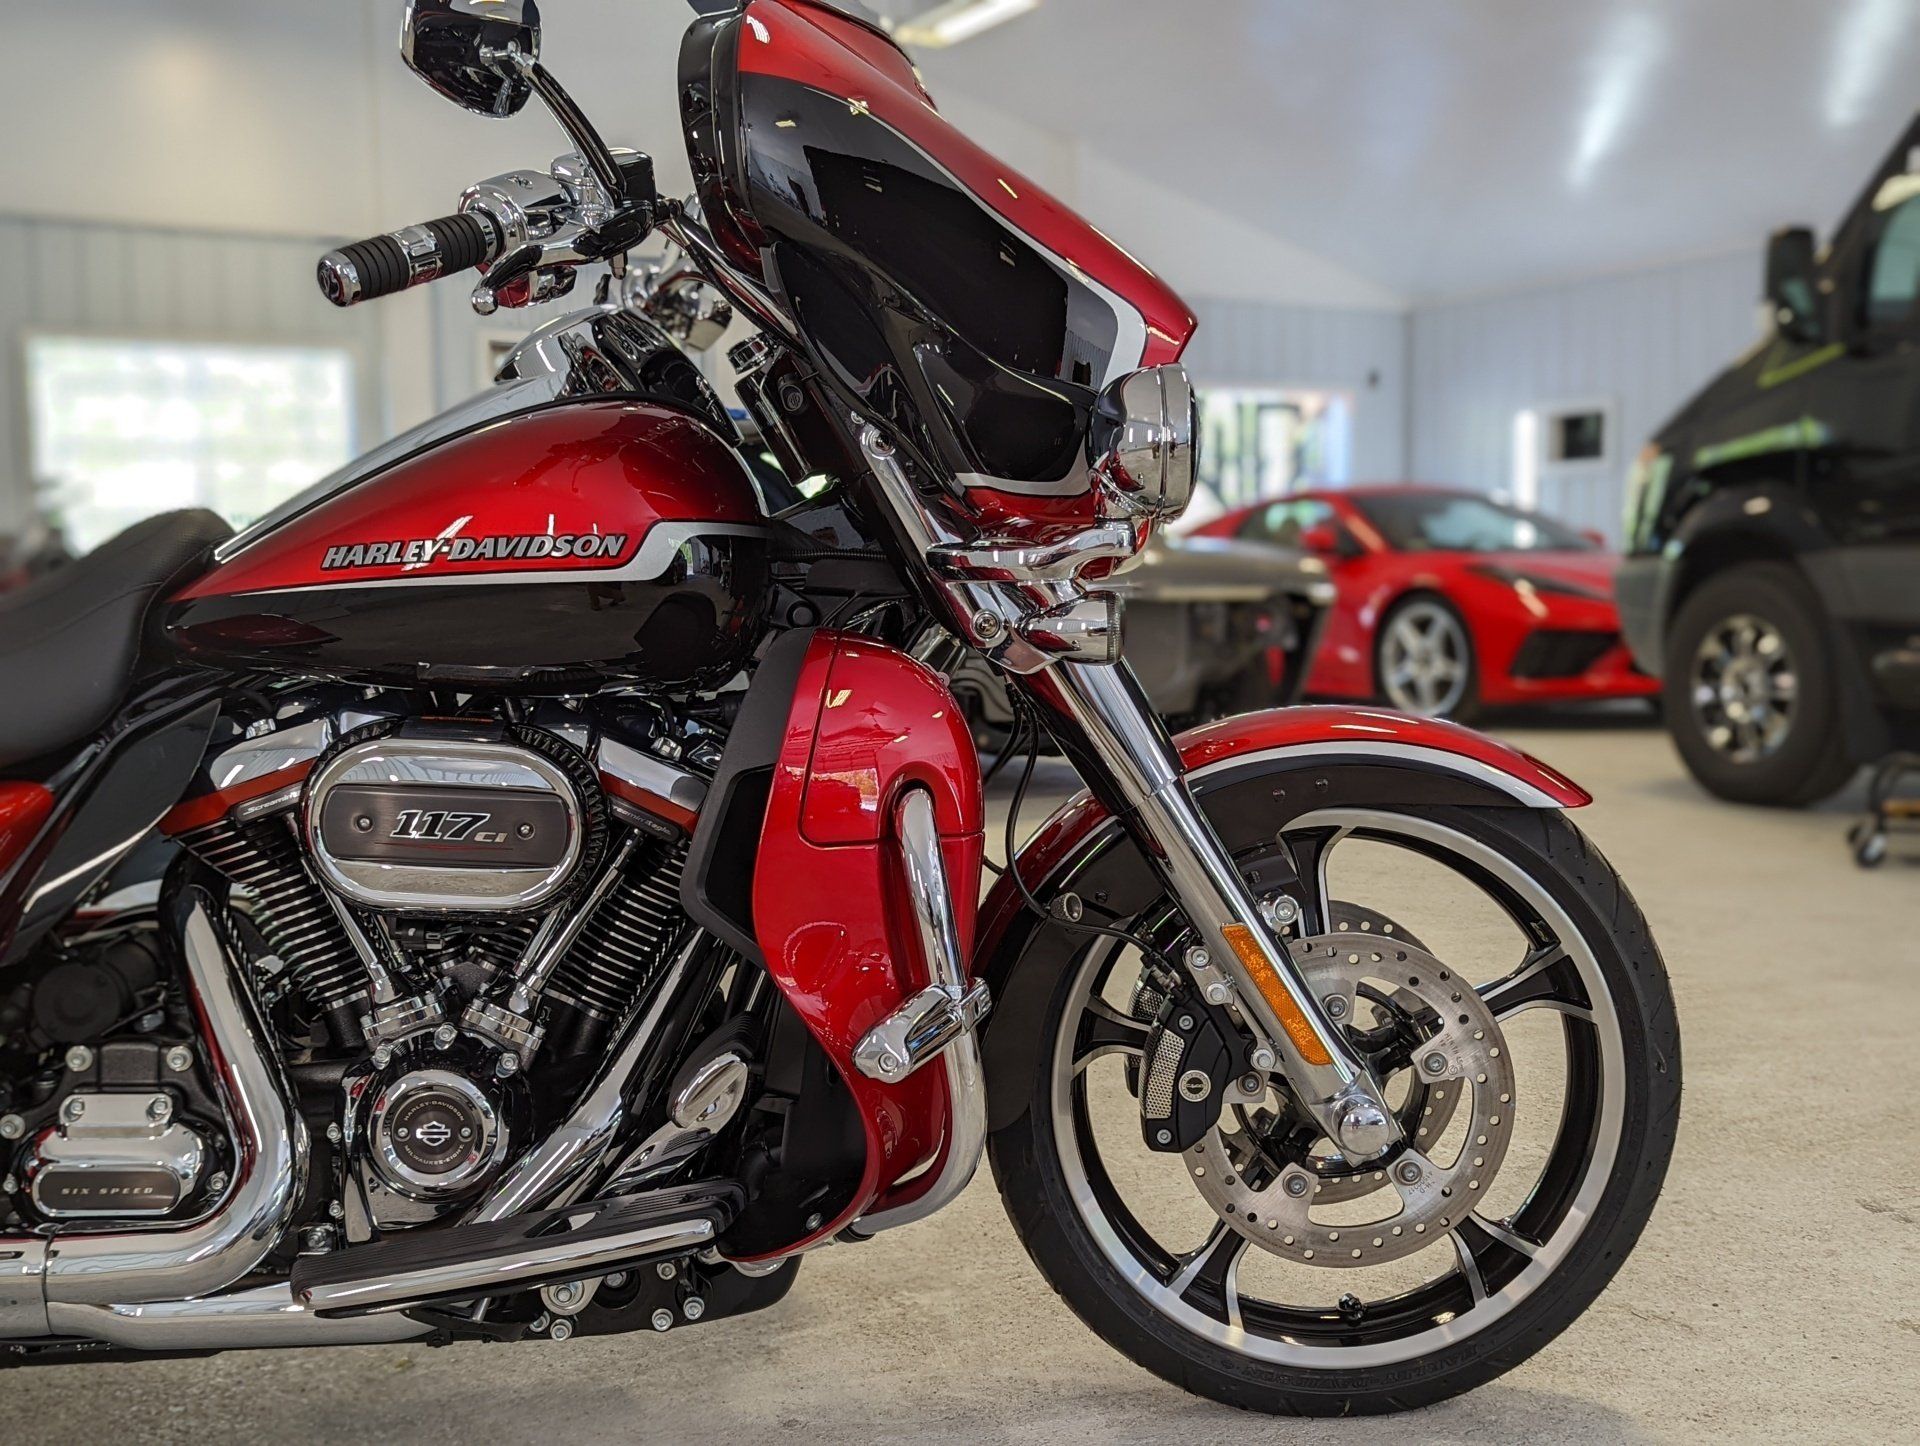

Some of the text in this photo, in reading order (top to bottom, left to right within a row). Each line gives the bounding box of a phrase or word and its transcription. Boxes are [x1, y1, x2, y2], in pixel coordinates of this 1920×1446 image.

[321, 533, 625, 569] HARLEY-DAVIDSON
[390, 809, 508, 843] 117 CI
[404, 1100, 465, 1121] HARLEY-DAVIDSON
[404, 1144, 465, 1165] MILWAUKEE-EIGHT
[61, 1186, 154, 1196] SIX SPEED
